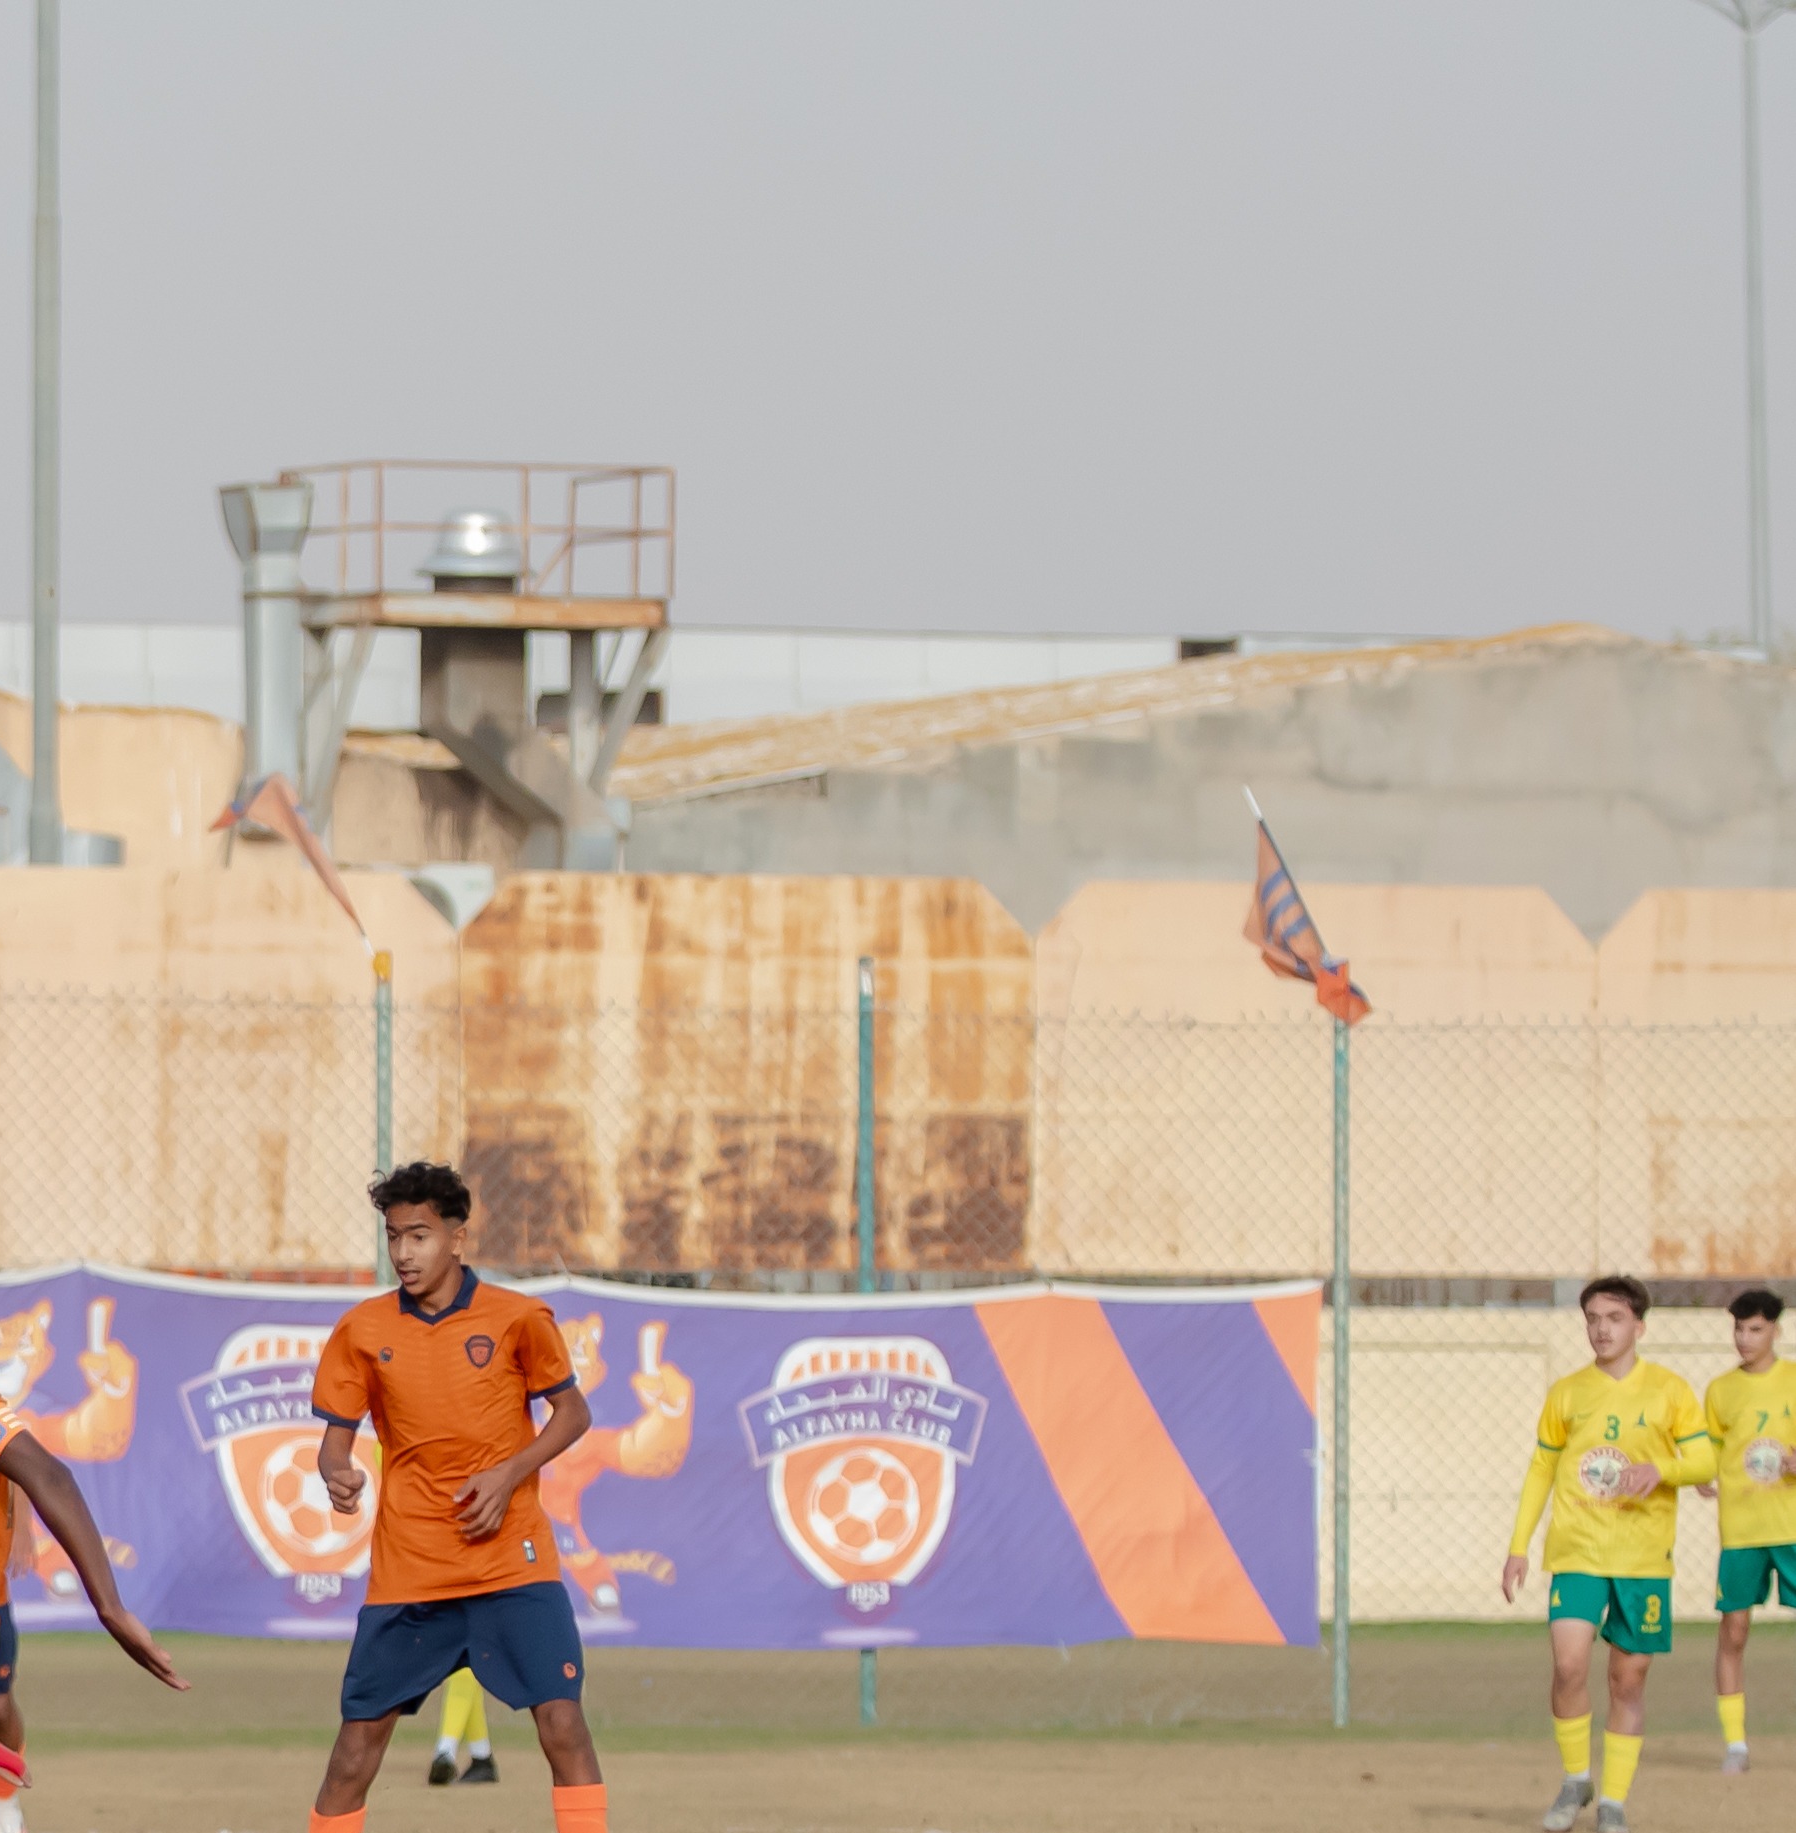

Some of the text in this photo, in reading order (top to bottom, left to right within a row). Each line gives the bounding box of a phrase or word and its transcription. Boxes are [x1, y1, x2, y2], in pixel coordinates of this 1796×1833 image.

[213, 1400, 313, 1435] ALFAYH
[772, 1410, 953, 1449] ALFAYHA CLUB
[1604, 1413, 1620, 1441] 3
